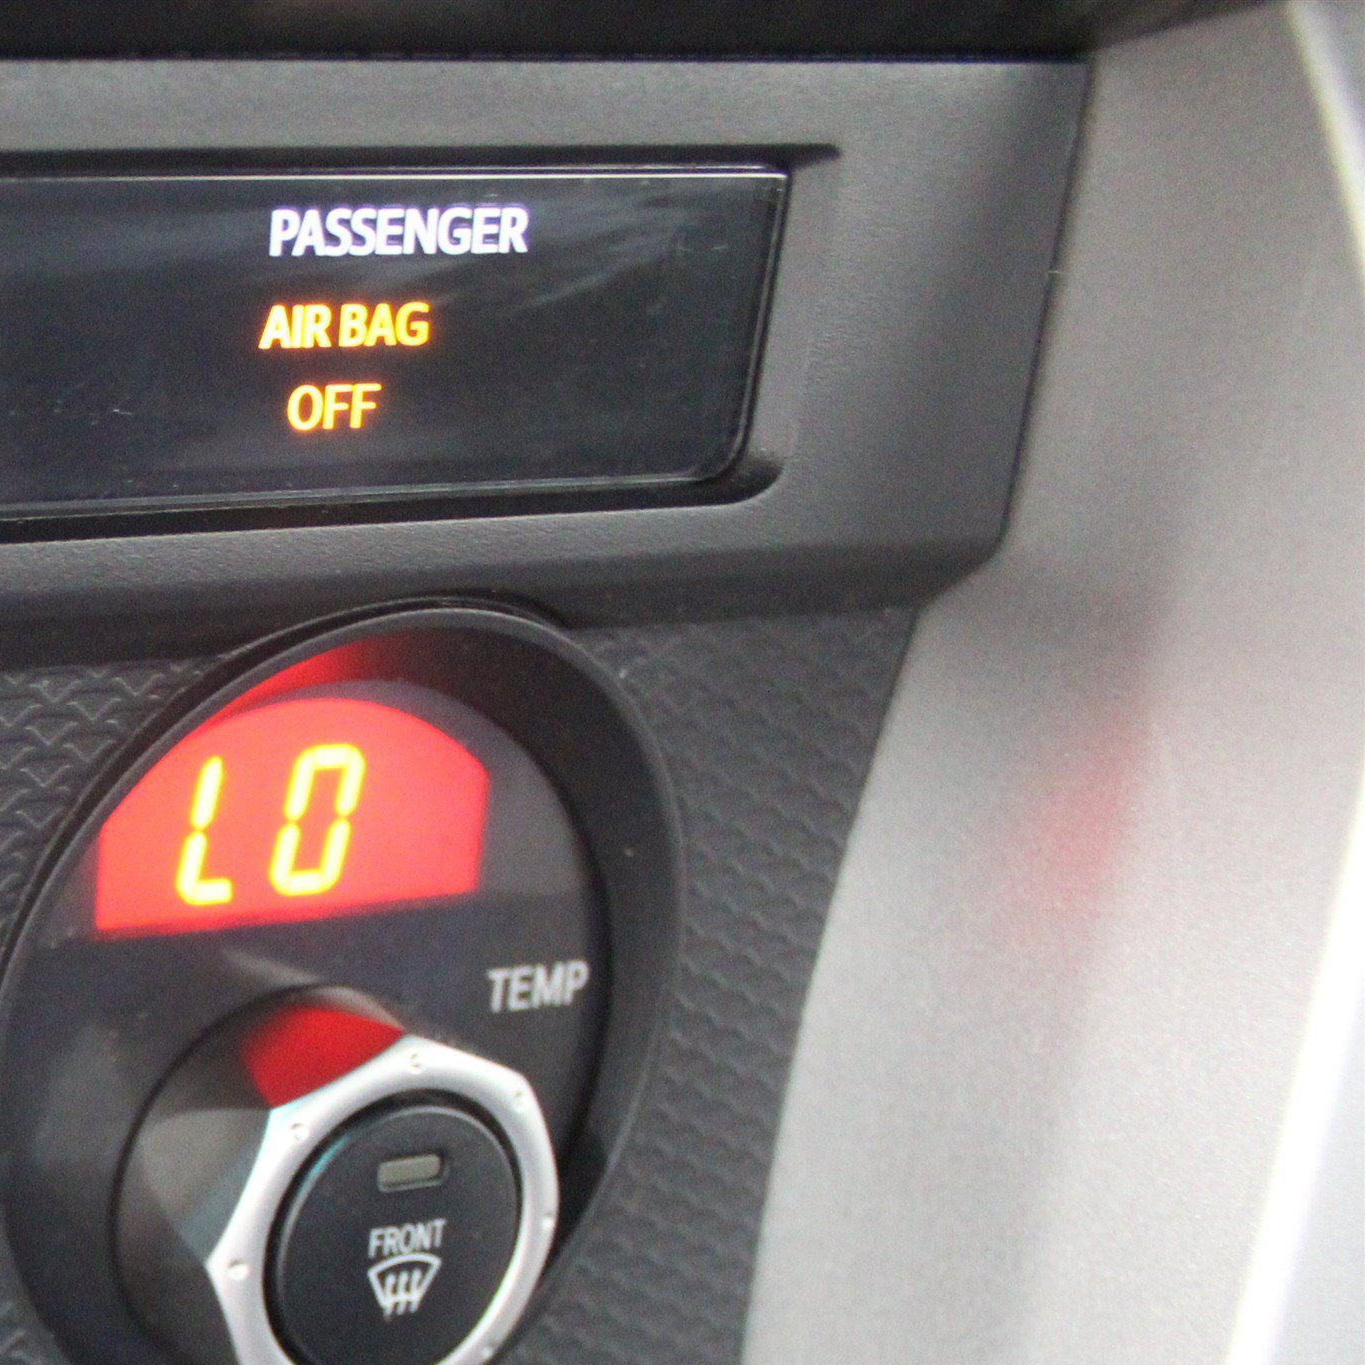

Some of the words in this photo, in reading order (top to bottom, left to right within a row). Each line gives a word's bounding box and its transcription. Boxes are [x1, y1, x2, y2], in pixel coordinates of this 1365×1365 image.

[268, 207, 530, 257] PASSENGER
[258, 303, 332, 350] AIR
[338, 301, 431, 348] BAG
[286, 382, 383, 432] OFF
[488, 960, 589, 1013] TEMP
[369, 1218, 447, 1259] FRONT
